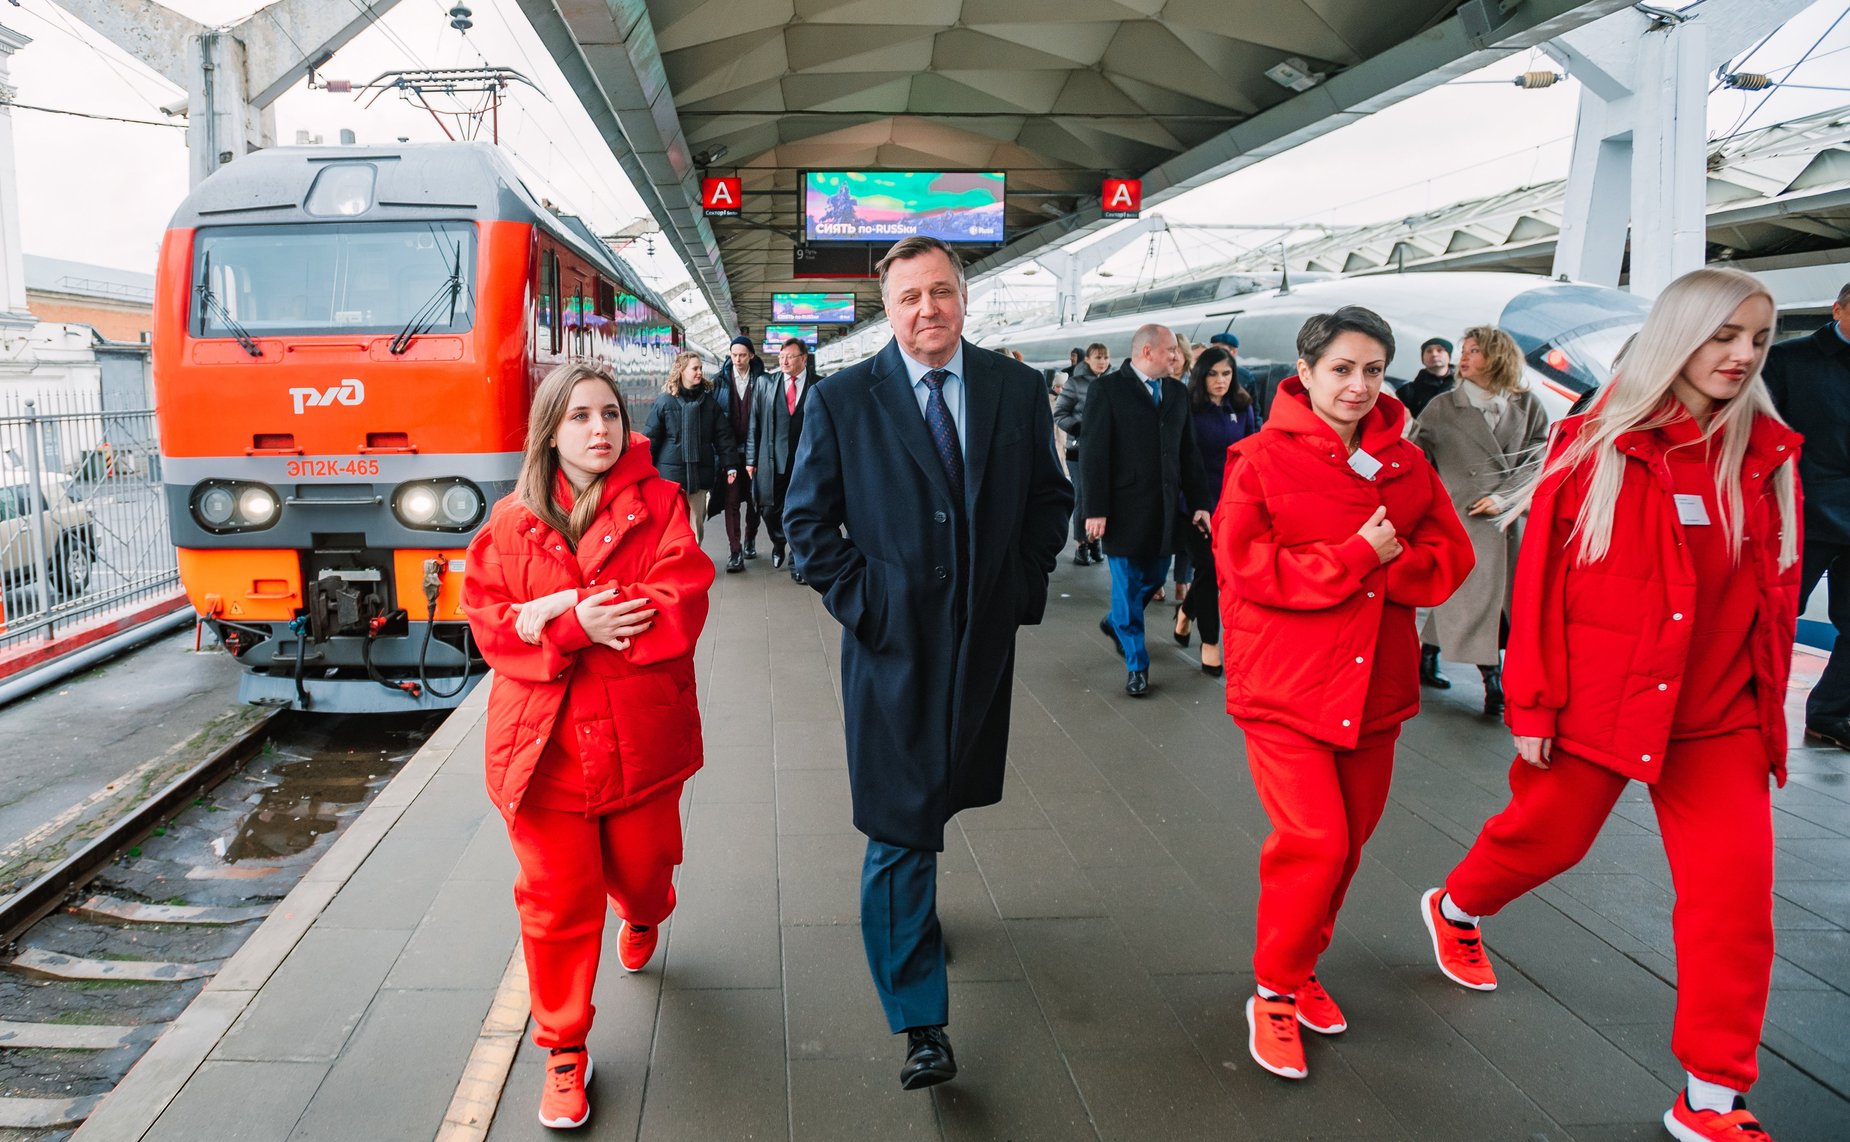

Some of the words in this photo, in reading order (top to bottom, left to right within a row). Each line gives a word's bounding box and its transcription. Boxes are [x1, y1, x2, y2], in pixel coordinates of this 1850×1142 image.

[815, 223, 857, 235] СИЯТЬ
[796, 249, 804, 260] 9
[286, 460, 380, 477] ЭП2К-465
